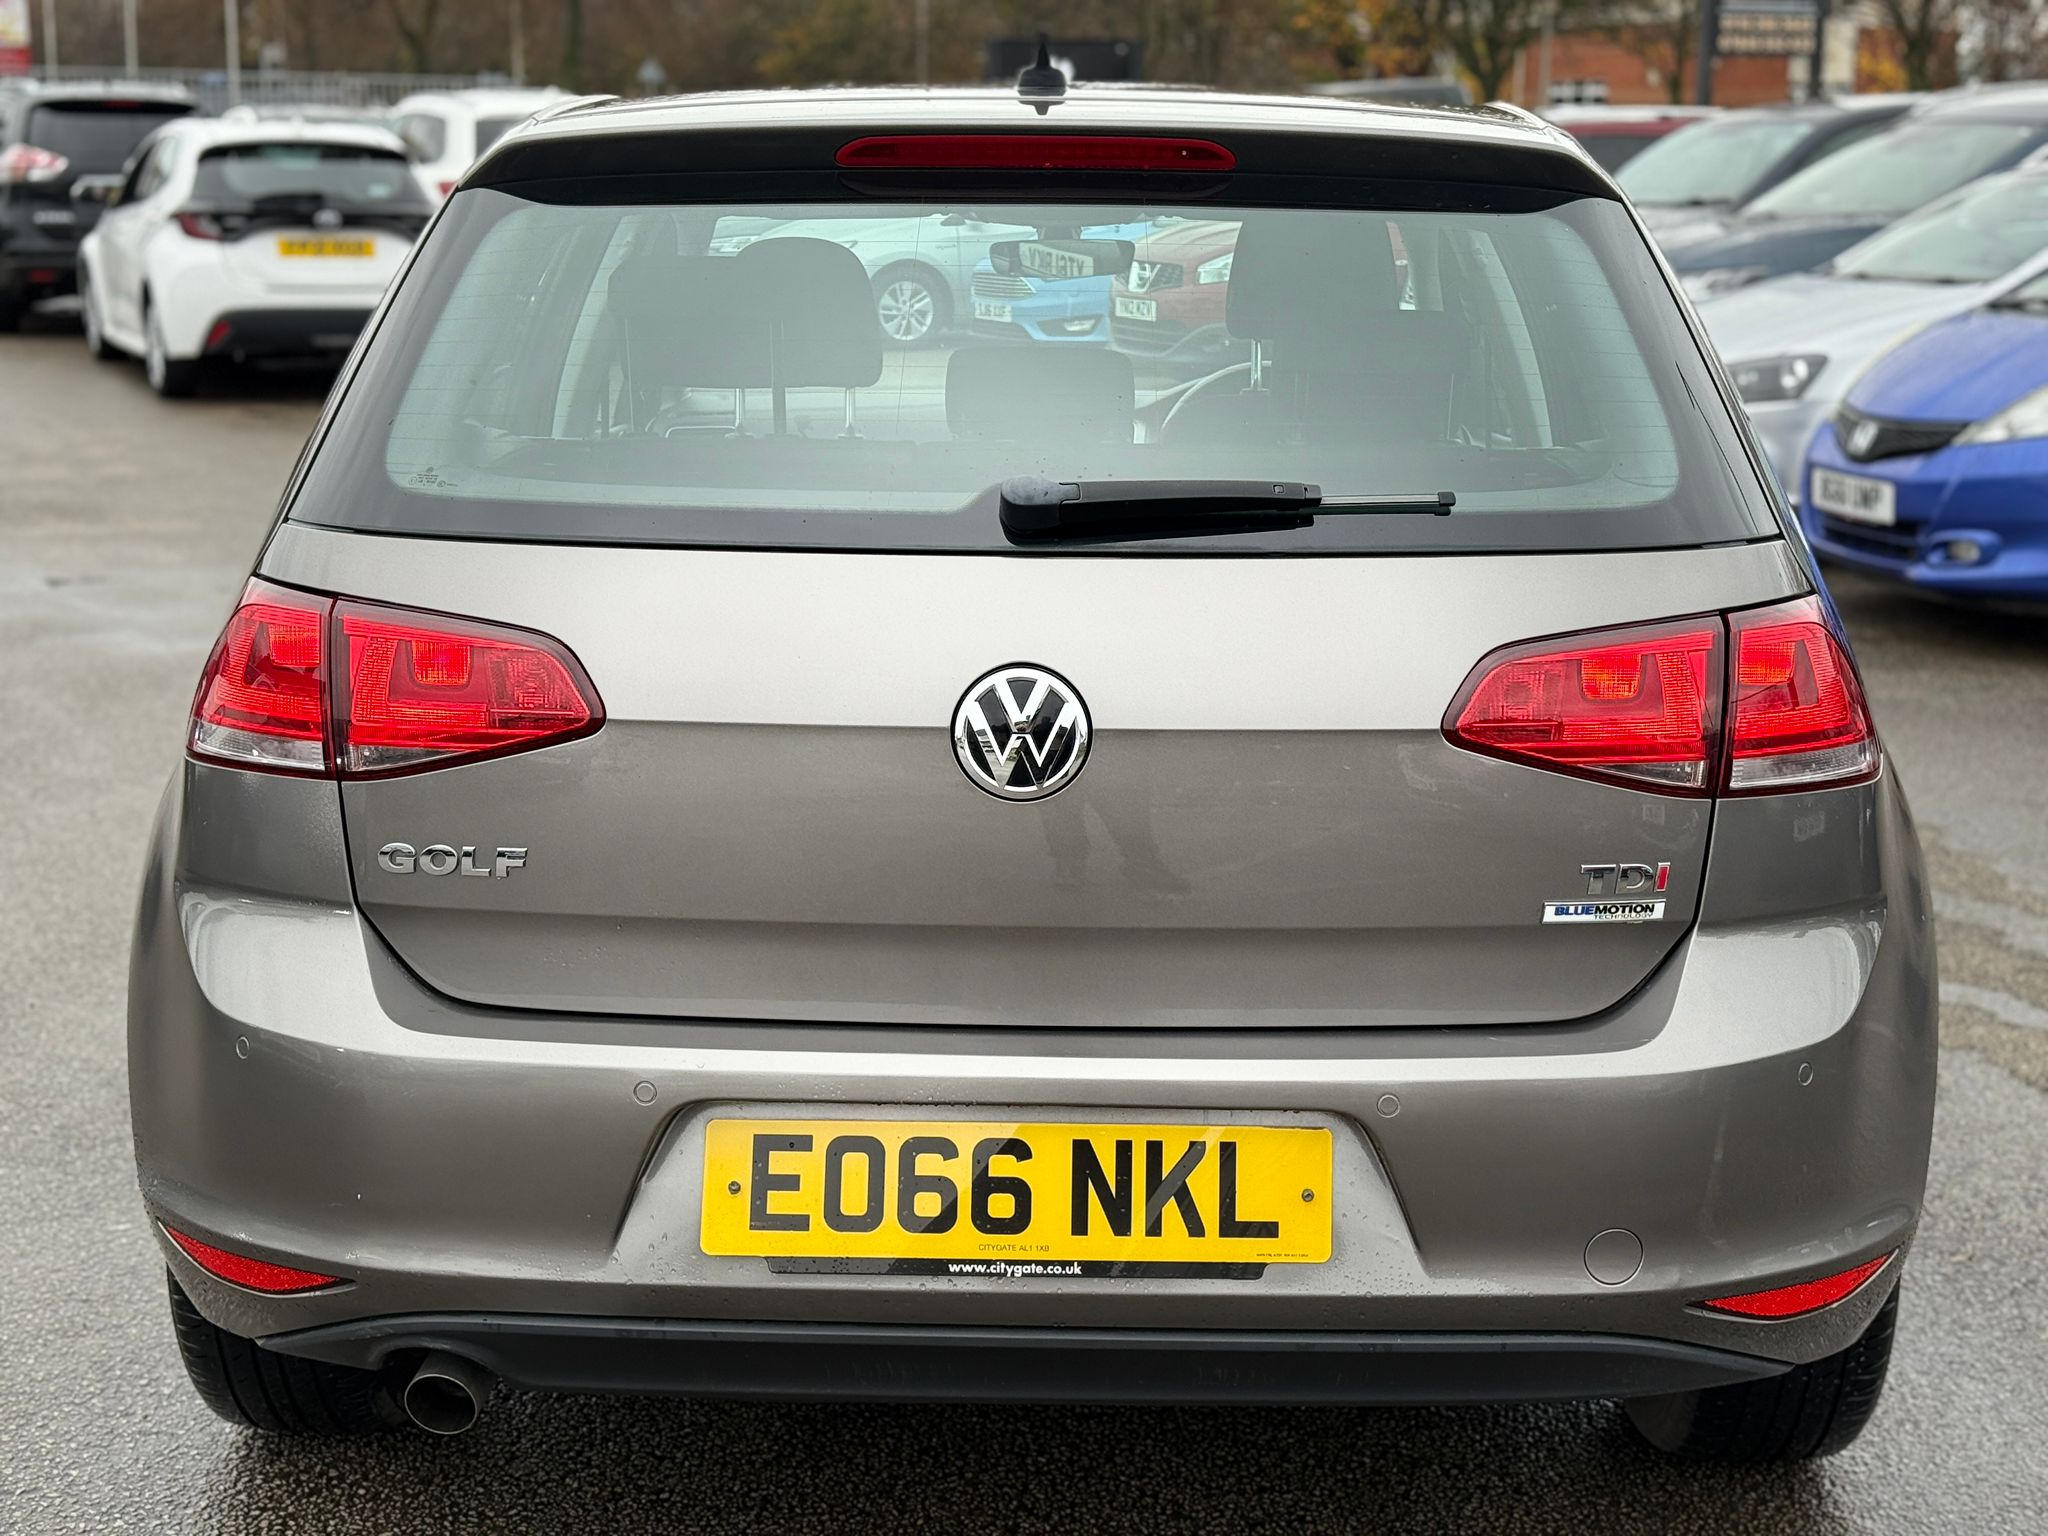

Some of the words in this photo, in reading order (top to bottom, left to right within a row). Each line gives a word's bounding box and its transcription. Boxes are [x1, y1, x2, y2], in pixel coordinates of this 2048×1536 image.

[377, 842, 528, 877] GOLF
[1580, 861, 1671, 895] TDI
[1554, 904, 1656, 916] BLUEMOTION
[749, 1134, 1033, 1236] EO66
[1071, 1138, 1280, 1238] NKL
[978, 1243, 1017, 1252] CITYGATE
[948, 1262, 1082, 1277] www.citygate.co.uk
